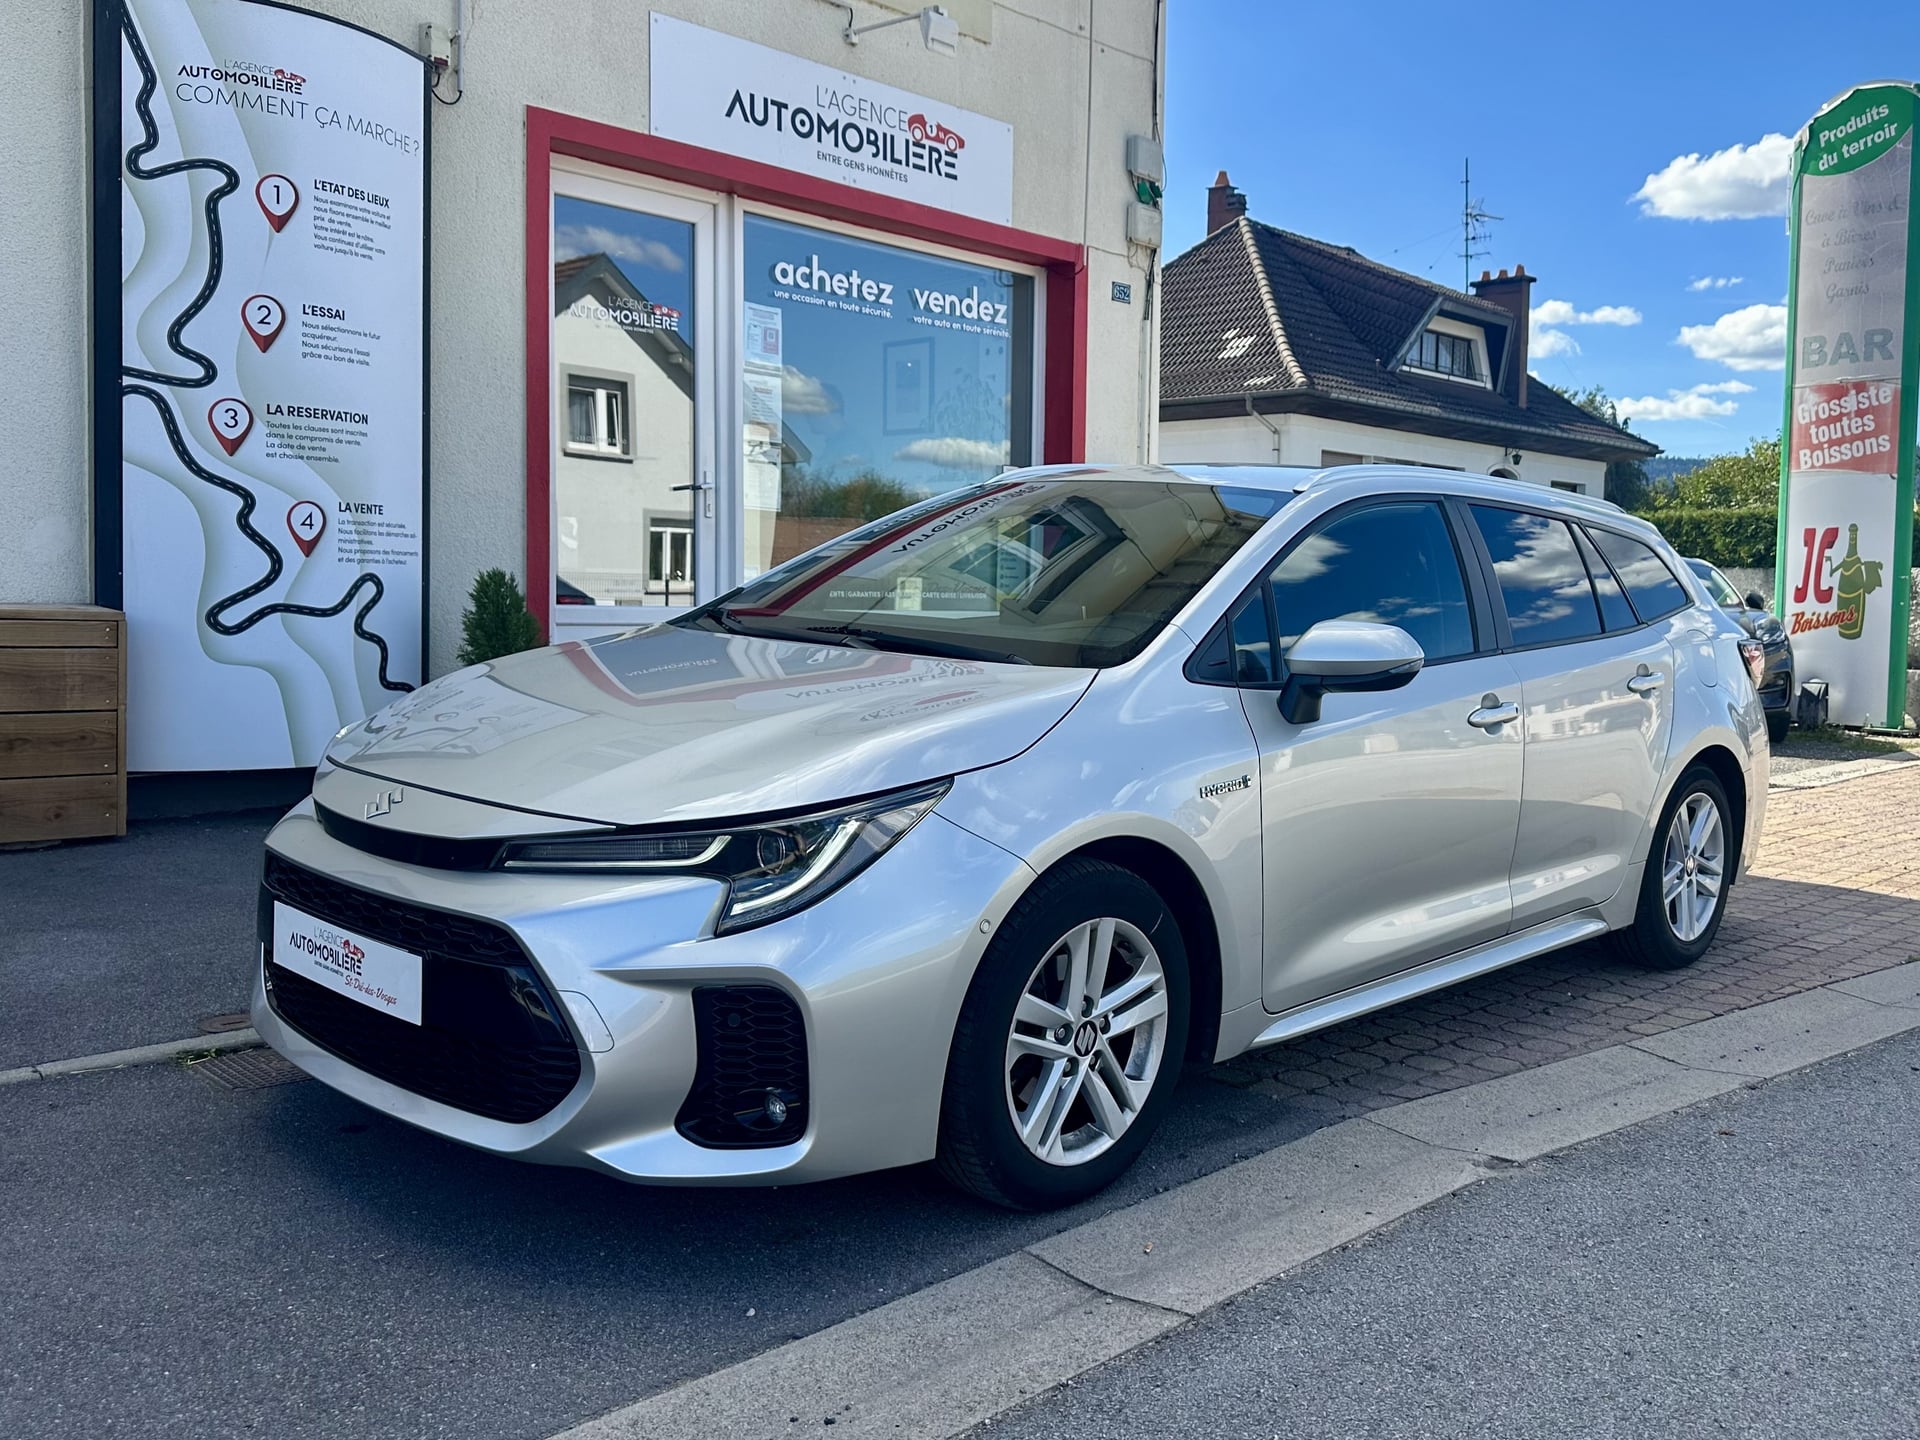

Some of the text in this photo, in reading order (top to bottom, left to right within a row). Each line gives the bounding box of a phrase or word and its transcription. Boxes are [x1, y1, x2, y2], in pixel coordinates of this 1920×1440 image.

[224, 58, 274, 76] L'AGENCE
[176, 83, 309, 120] COMMENT
[314, 106, 342, 128] ÇA
[347, 114, 410, 154] MARCHE
[816, 84, 908, 132] L'AGENCE
[1819, 104, 1889, 148] Produits
[1818, 122, 1898, 172] du terroir
[816, 150, 908, 184] ENTRE GENS HONNÊTES
[273, 184, 281, 205] 1
[314, 179, 390, 209] L'ETAT DES LIEUX
[774, 254, 894, 305] achetez
[608, 296, 654, 312] L'AGENCE
[774, 290, 790, 299] une
[792, 294, 826, 306] occasion
[828, 300, 837, 308] en
[839, 301, 860, 312] toute
[1114, 286, 1130, 300] 652
[256, 304, 272, 326] 2
[302, 304, 345, 321] L'ESSAI
[914, 286, 1008, 324] vendez
[302, 321, 319, 330] Nous
[913, 316, 932, 326] votre
[934, 319, 950, 328] auto
[952, 322, 961, 330] en
[962, 323, 981, 333] toute
[302, 340, 319, 349] Nous
[1801, 327, 1894, 370] BAR
[267, 403, 368, 425] LA RESERVATION
[1798, 384, 1893, 425] Grossiste
[223, 408, 239, 429] 3
[266, 421, 291, 430] Toutes
[292, 423, 302, 431] les
[304, 424, 329, 433] clauses
[1809, 411, 1876, 445] toutes
[266, 431, 285, 439] dans
[287, 432, 293, 440] le
[295, 434, 333, 443] compromis
[277, 442, 294, 450] date
[1798, 434, 1891, 472] Boissons
[339, 502, 384, 515] LA VENTE
[300, 512, 315, 530] 4
[1793, 527, 1840, 604] JC
[1791, 604, 1857, 636] Boissons
[1200, 778, 1243, 798] HYBRID
[314, 926, 344, 949] L'AGENCE
